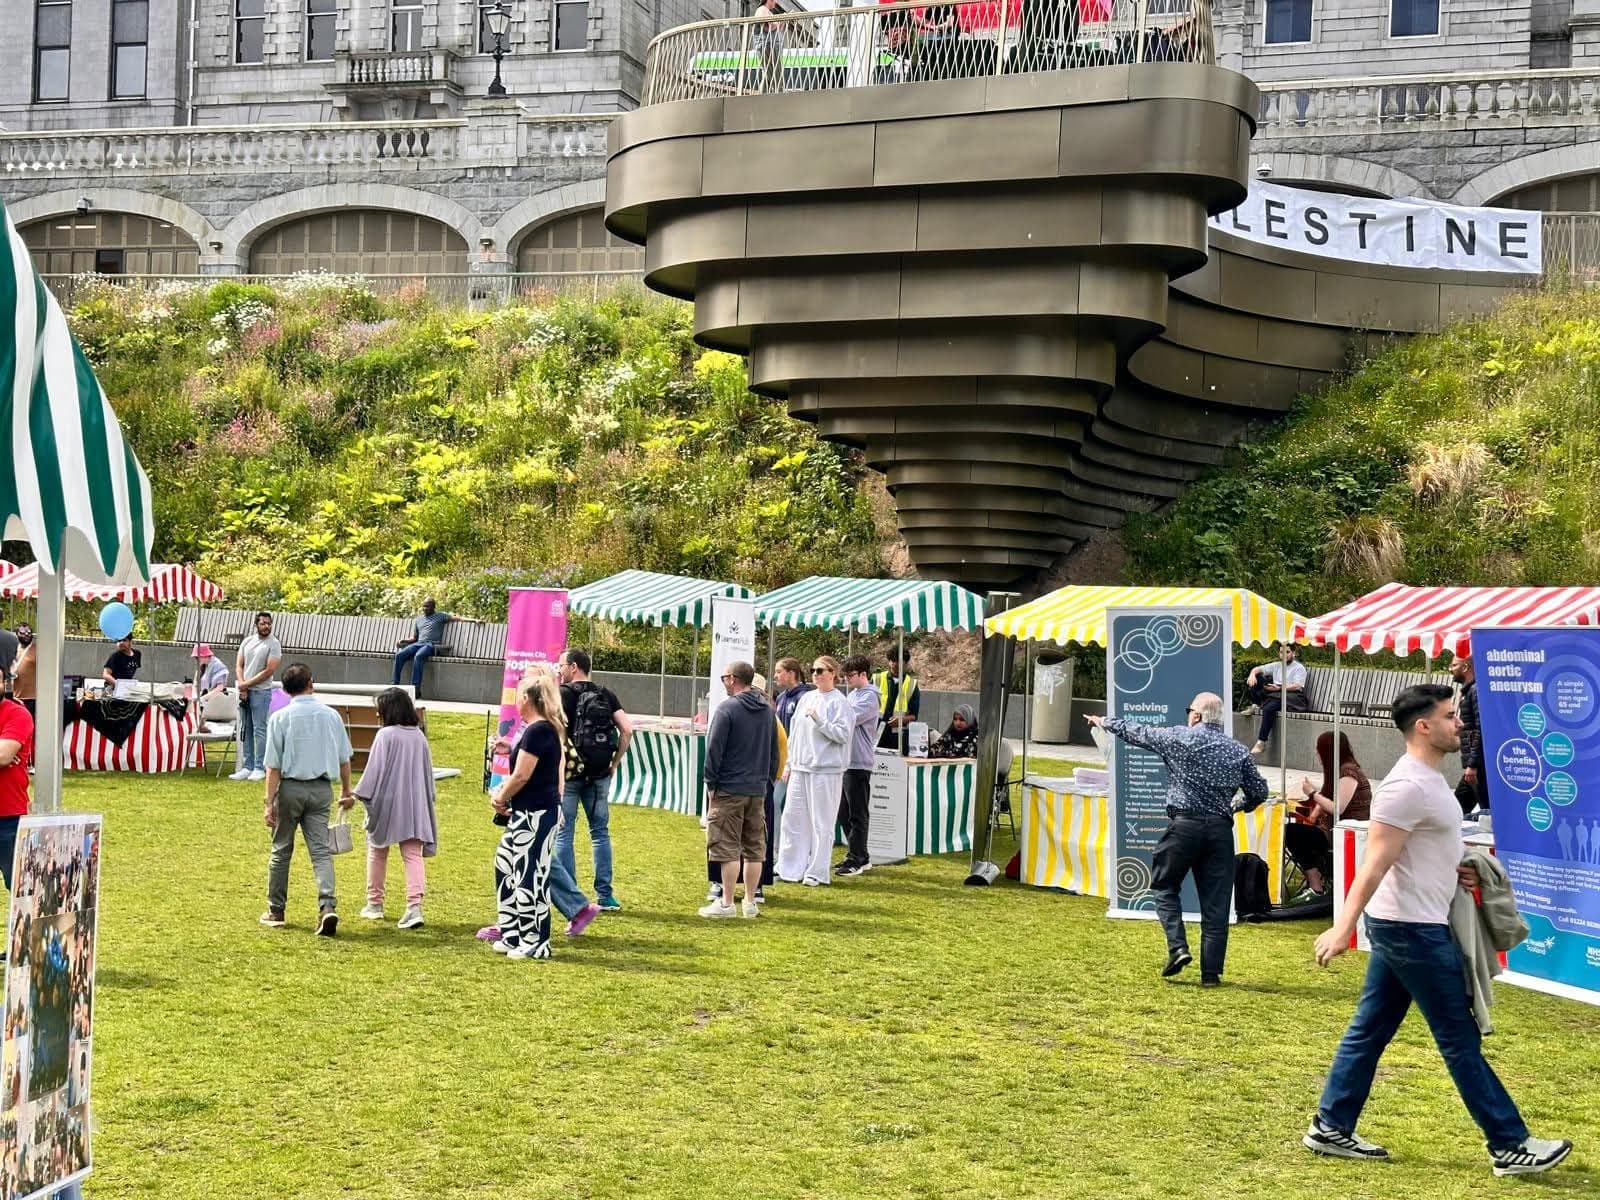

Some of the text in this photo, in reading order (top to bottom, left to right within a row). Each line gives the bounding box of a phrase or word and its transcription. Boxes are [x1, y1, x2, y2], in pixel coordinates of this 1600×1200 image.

[1215, 199, 1529, 259] LESTINE
[1486, 649, 1545, 662] abdominal
[1488, 664, 1522, 676] aortic
[1490, 680, 1544, 693] aneurysm
[1124, 702, 1168, 713] Evolving
[1124, 714, 1166, 724] through
[1512, 744, 1526, 755] the
[1503, 754, 1536, 766] benefits
[1513, 766, 1536, 776] getting
[1506, 774, 1536, 782] screened
